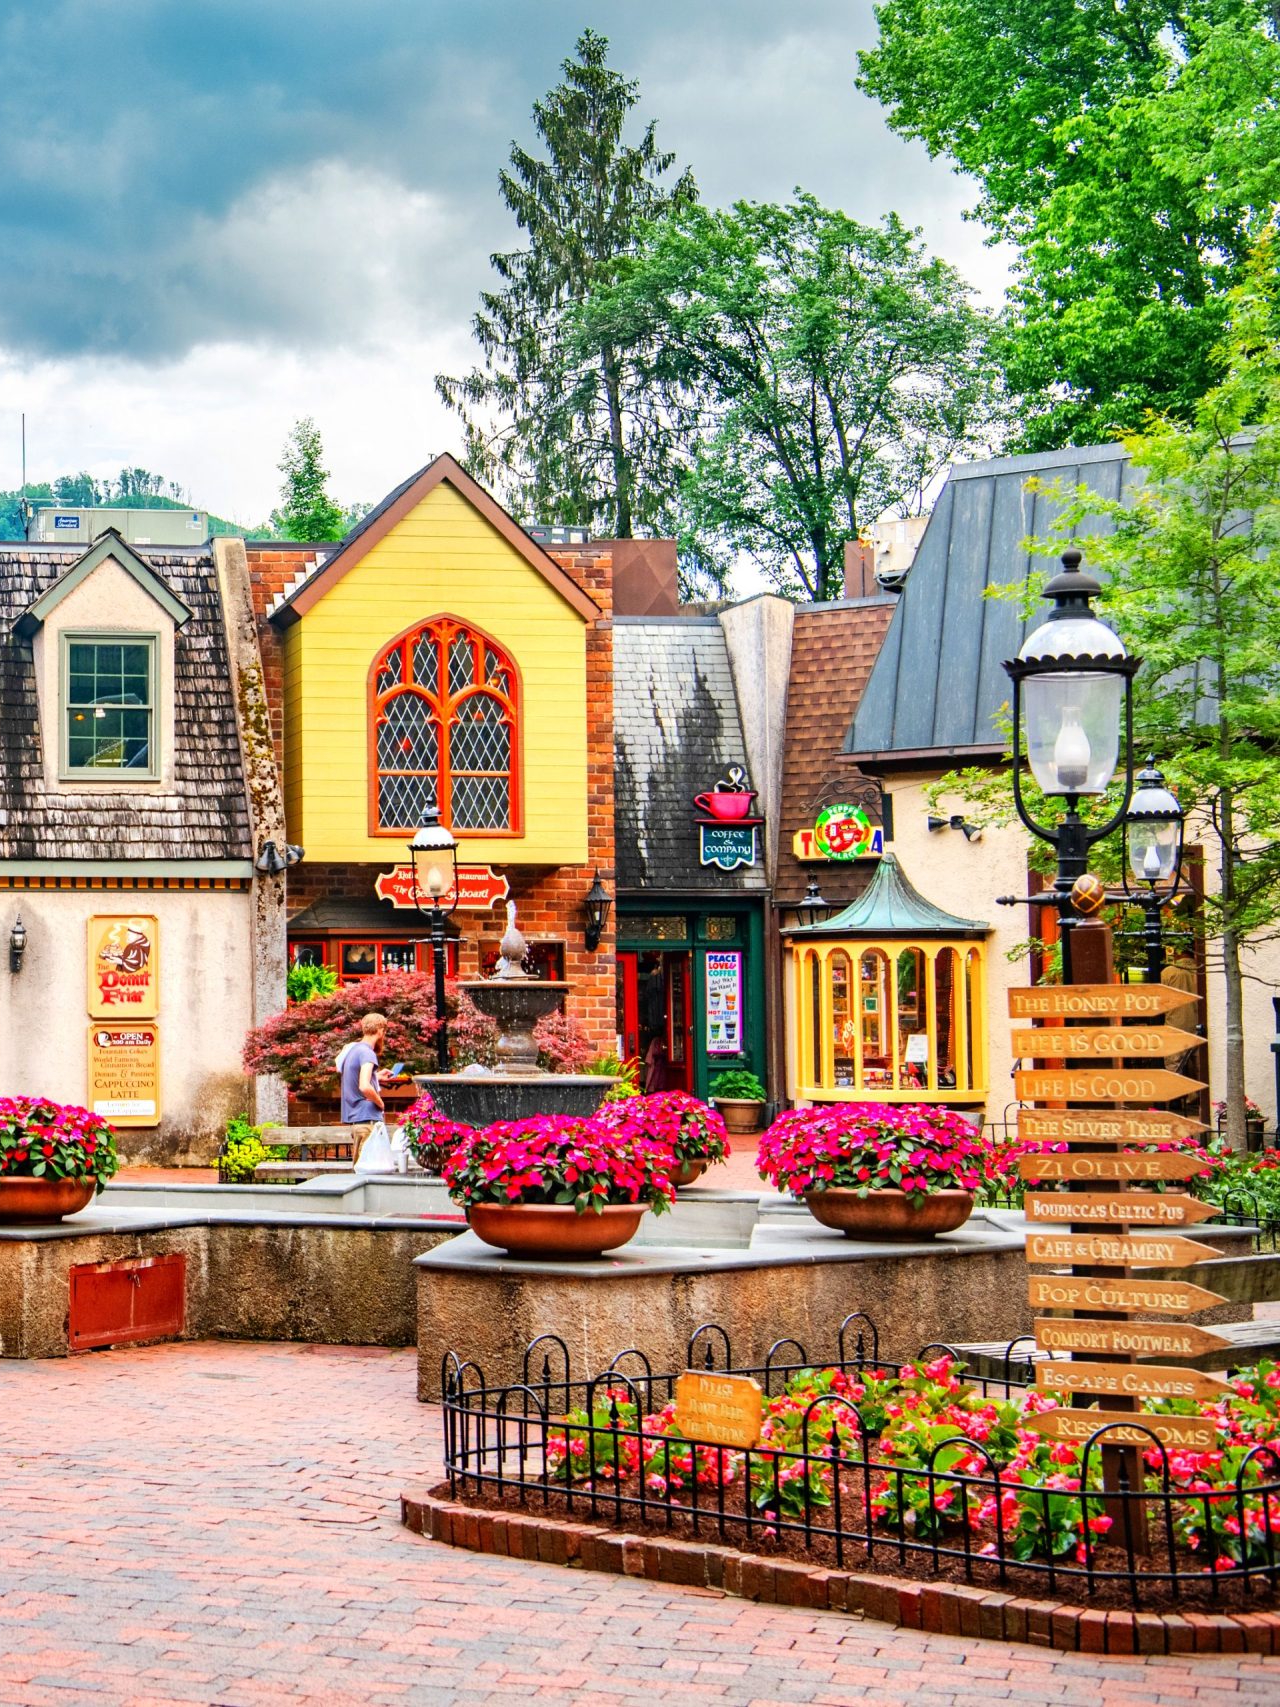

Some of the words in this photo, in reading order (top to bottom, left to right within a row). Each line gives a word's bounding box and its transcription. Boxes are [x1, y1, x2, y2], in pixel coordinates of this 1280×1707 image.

[828, 805, 858, 815] PEPPER
[712, 830, 744, 838] COFFEE
[704, 846, 750, 854] COMPANY
[826, 849, 858, 859] PALACE
[98, 971, 151, 988] Donut
[100, 986, 144, 1005] Friar
[1014, 995, 1048, 1013] THE
[1054, 996, 1118, 1013] HONEY
[1125, 993, 1160, 1011] POT
[1018, 1036, 1066, 1052] LIFE
[1070, 1035, 1089, 1052] IS
[1094, 1034, 1164, 1052] GOOD
[120, 1070, 127, 1078] &
[94, 1079, 154, 1088] CAPPUCCINO
[1022, 1077, 1064, 1097] LIFE
[1070, 1078, 1087, 1097] IS
[1091, 1076, 1156, 1098] GOOD
[111, 1090, 139, 1099] LATTE
[1023, 1118, 1058, 1136] THE
[1063, 1118, 1121, 1137] SILVER
[1128, 1120, 1171, 1138] TREE
[1072, 1159, 1161, 1176] OLIVE
[1033, 1200, 1106, 1218] BOUDICCA'S
[1109, 1202, 1155, 1219] CELTIC
[1158, 1202, 1184, 1220] PUB
[1033, 1237, 1072, 1257] CAFE
[1075, 1243, 1087, 1256] &
[1090, 1239, 1174, 1261] CREAMERY
[1038, 1284, 1080, 1303] POP
[1085, 1286, 1190, 1310] CULTURE
[1041, 1328, 1108, 1348] COMFORT
[1112, 1331, 1192, 1353] FOOTWEAR
[1042, 1368, 1117, 1390] ESCAPE
[1122, 1374, 1195, 1394] GAMES
